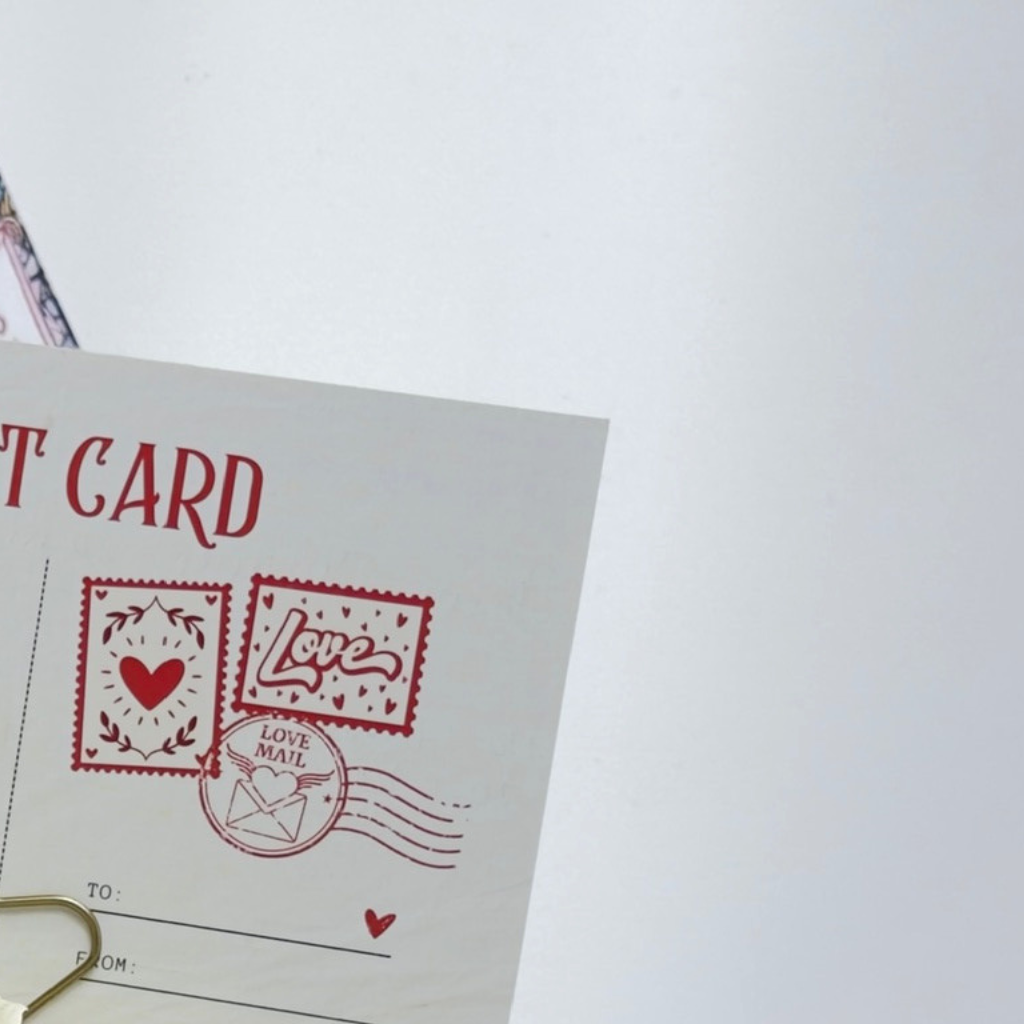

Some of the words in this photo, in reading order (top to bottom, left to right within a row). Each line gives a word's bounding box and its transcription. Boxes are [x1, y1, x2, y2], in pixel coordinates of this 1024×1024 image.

[66, 436, 263, 549] CARD
[256, 607, 403, 694] Love
[259, 723, 312, 751] LOVE
[254, 743, 307, 769] MAIL
[87, 882, 121, 901] TO:
[75, 950, 136, 975] FOM:
